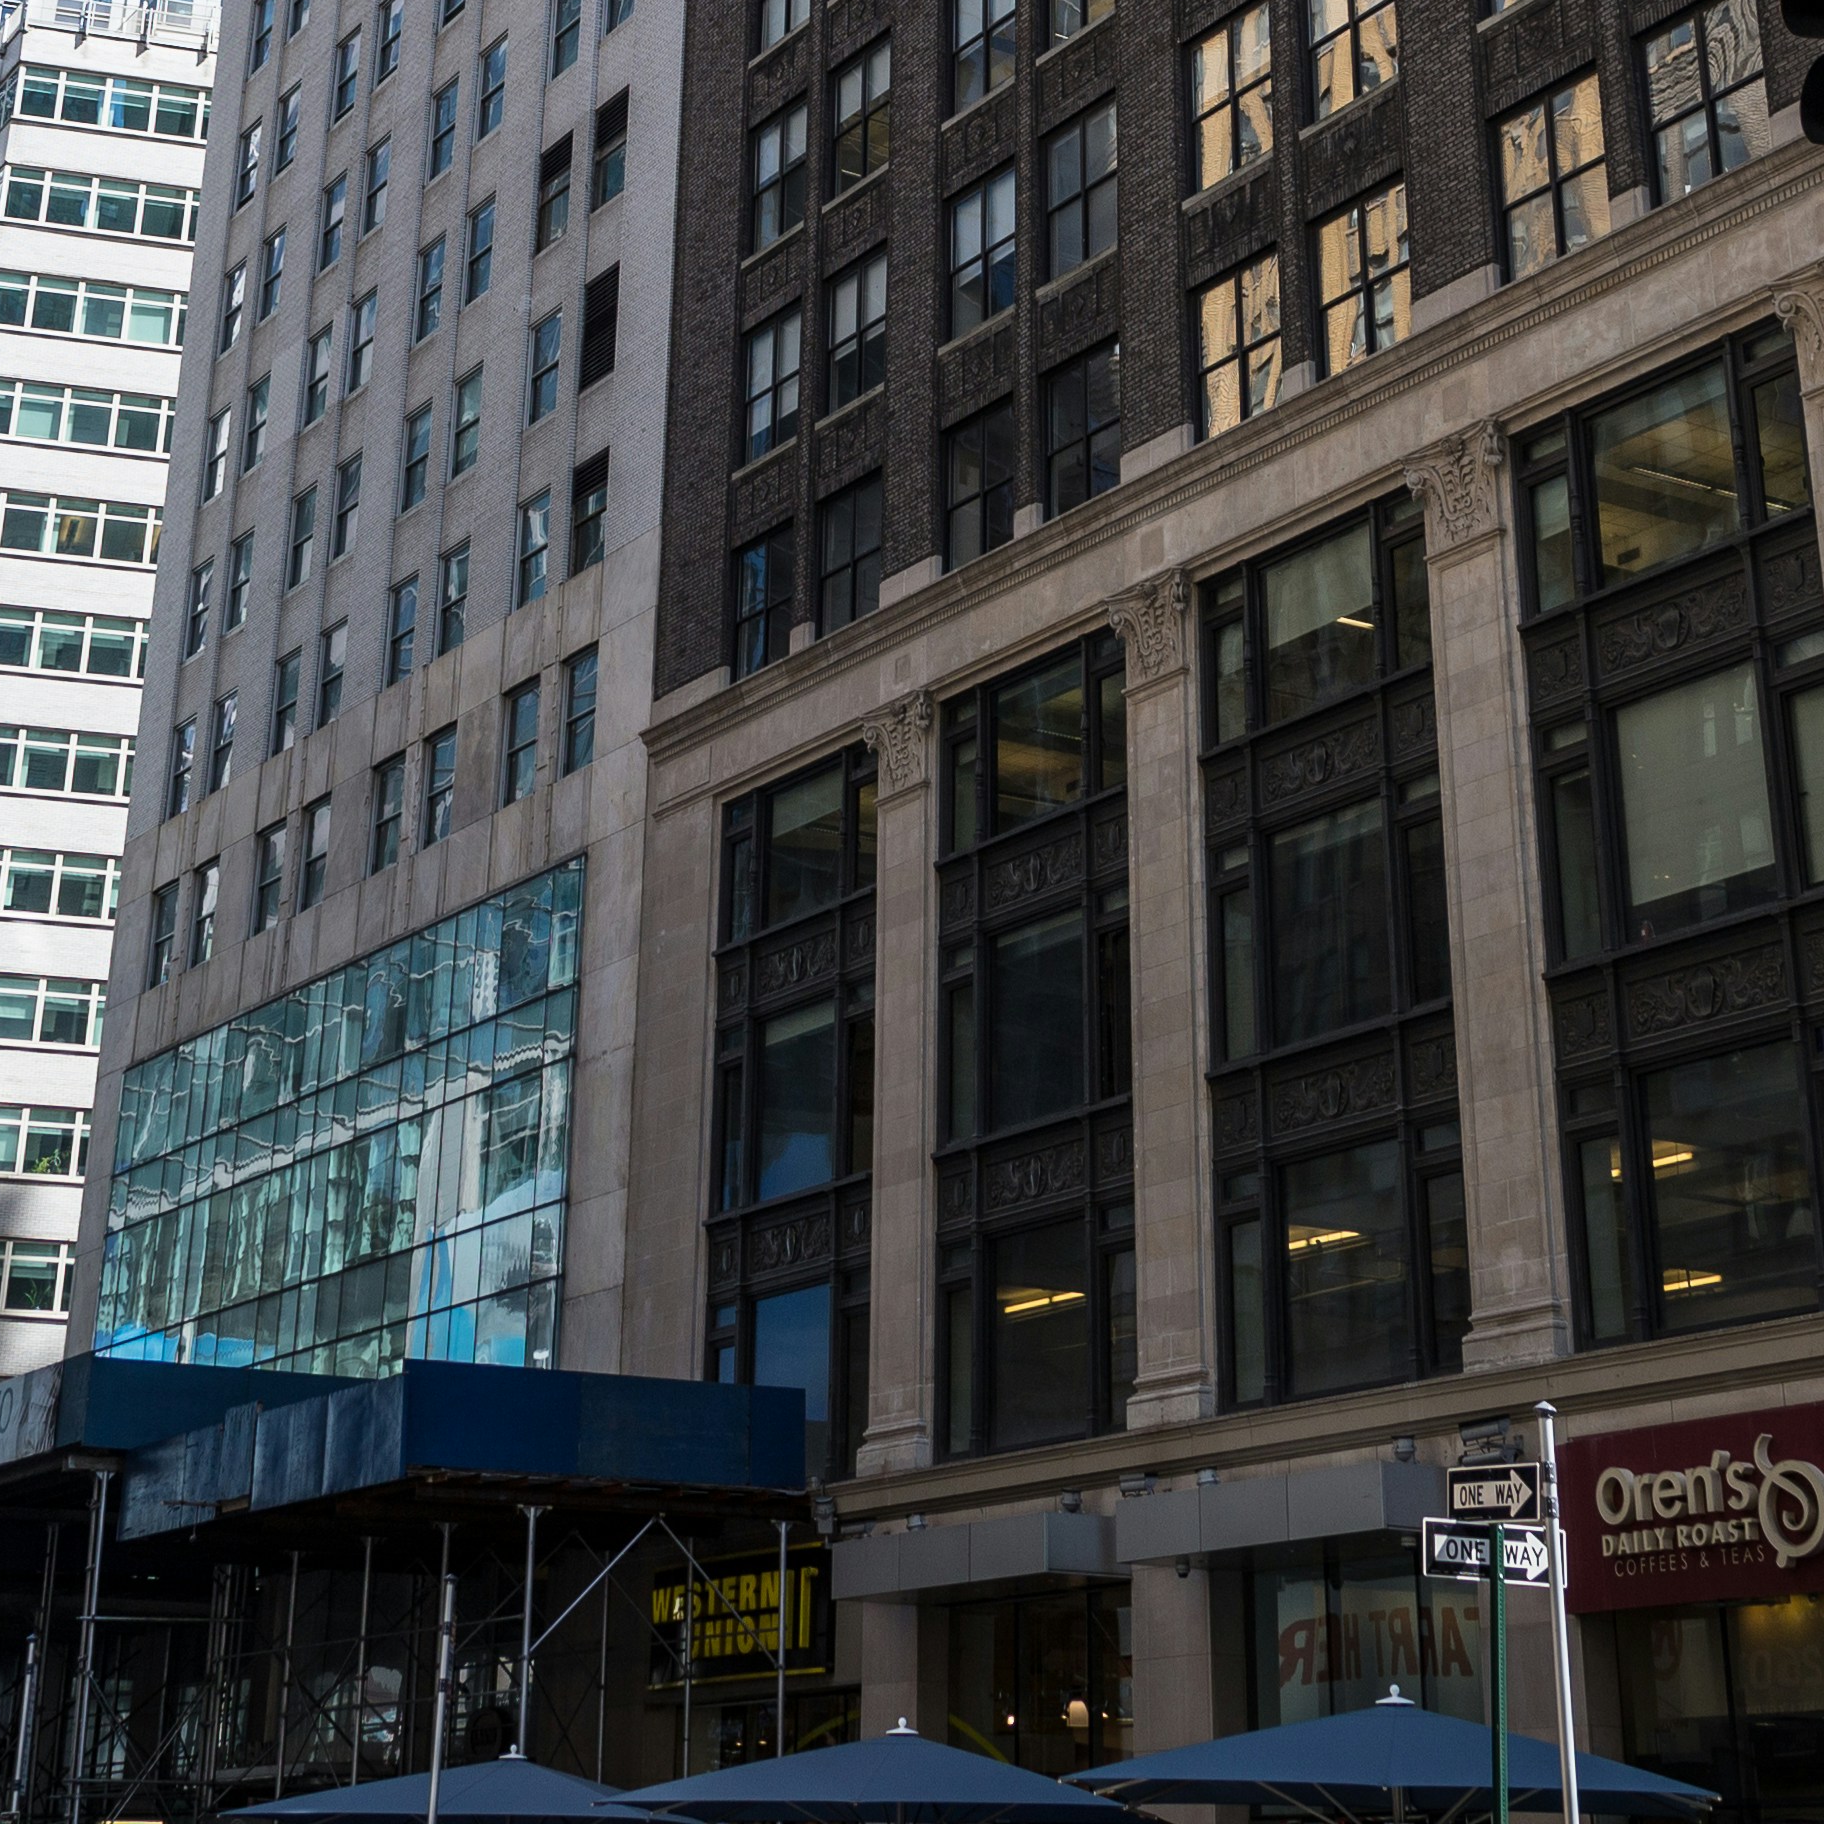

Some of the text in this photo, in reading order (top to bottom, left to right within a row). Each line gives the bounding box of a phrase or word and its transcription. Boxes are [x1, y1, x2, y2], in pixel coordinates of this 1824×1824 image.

[1460, 1483, 1523, 1506] ONE WAY
[1596, 1449, 1759, 1525] Oren's
[1446, 1539, 1543, 1567] ONE WAY
[1602, 1517, 1759, 1557] DAILY ROAST
[1615, 1545, 1765, 1577] COFFEES & TEAS
[652, 1569, 784, 1624] WESTERN
